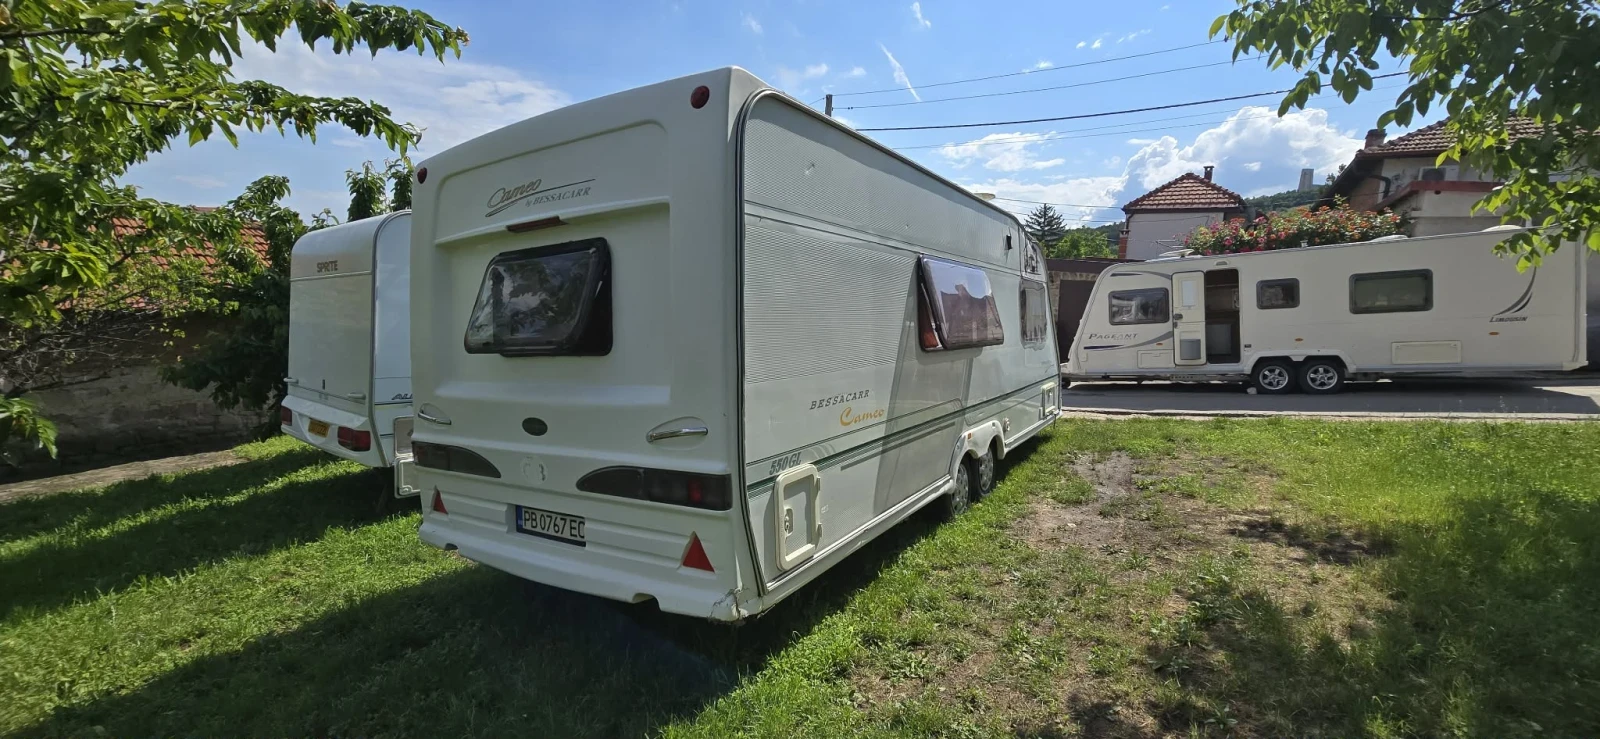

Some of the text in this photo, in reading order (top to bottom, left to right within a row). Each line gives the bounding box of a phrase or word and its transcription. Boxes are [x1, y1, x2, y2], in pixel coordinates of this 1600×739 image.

[487, 179, 542, 208] Cameo
[525, 187, 592, 207] by BESSACARR
[316, 260, 339, 273] SPRITE
[809, 389, 870, 410] BESSACARR
[840, 406, 885, 426] Cameo
[523, 510, 538, 529] PB
[540, 513, 567, 535] 0767
